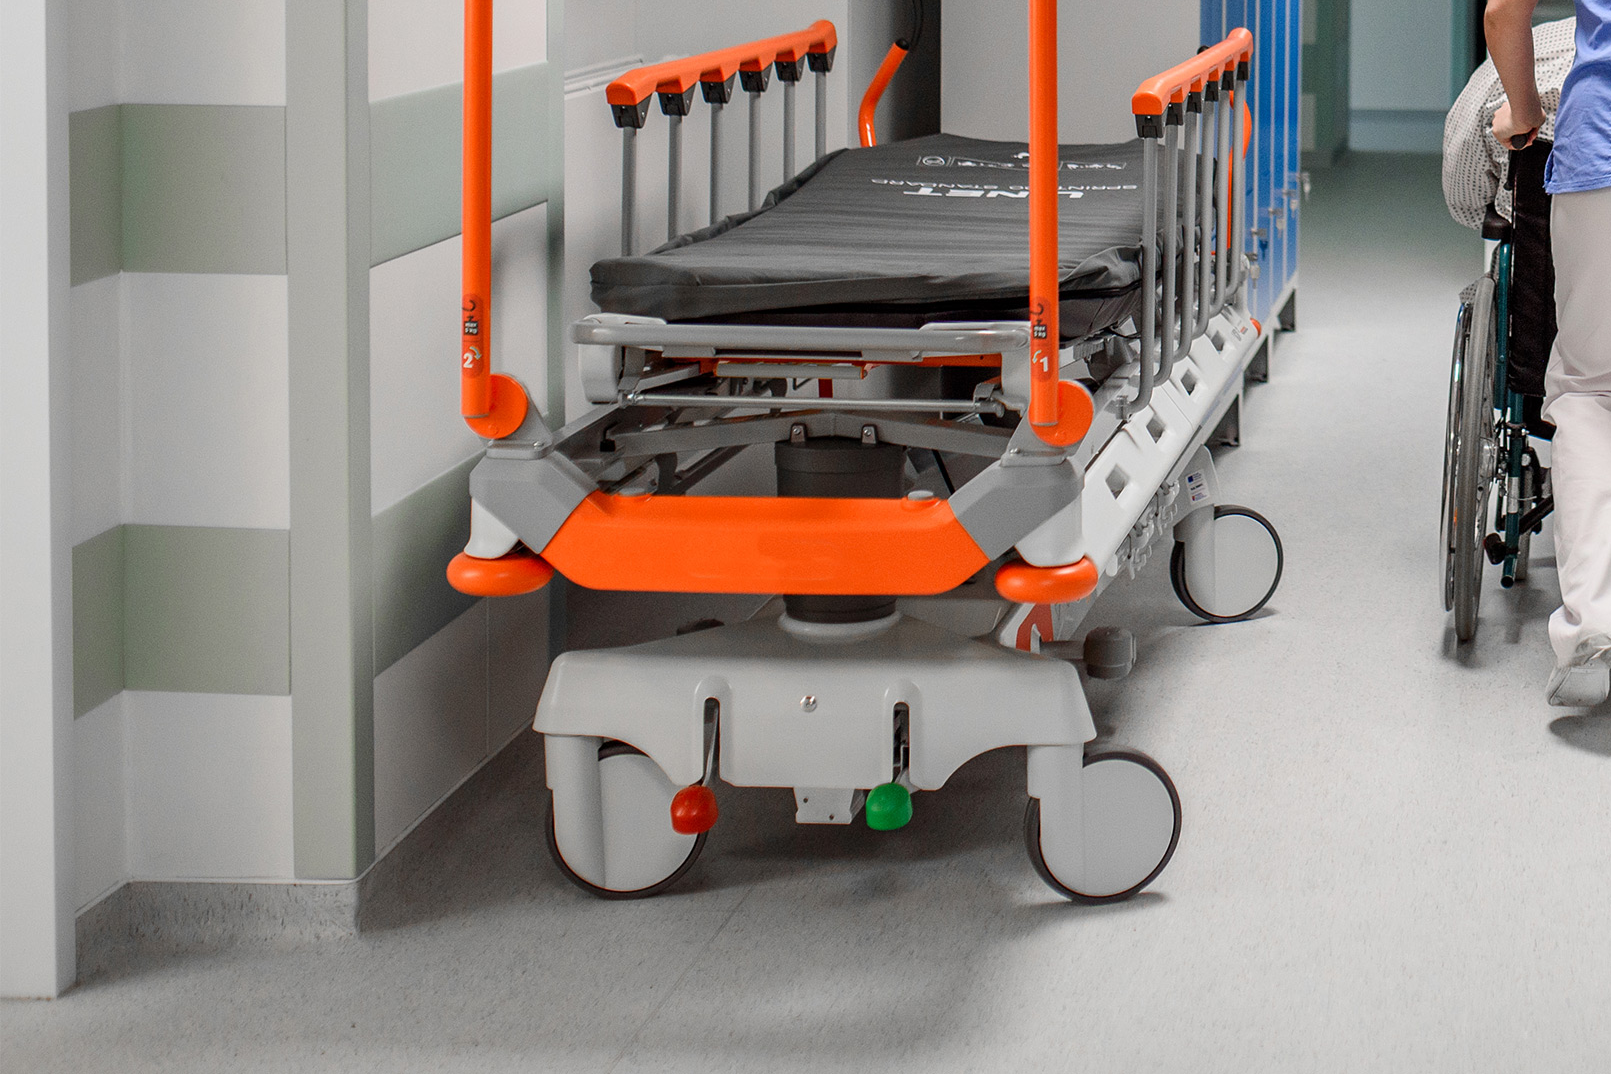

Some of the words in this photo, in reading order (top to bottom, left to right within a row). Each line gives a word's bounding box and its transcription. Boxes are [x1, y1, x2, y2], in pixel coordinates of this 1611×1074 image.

[871, 178, 998, 190] STANDARD
[903, 187, 1084, 199] LNET
[463, 352, 474, 369] 2
[1040, 356, 1048, 372] 1
